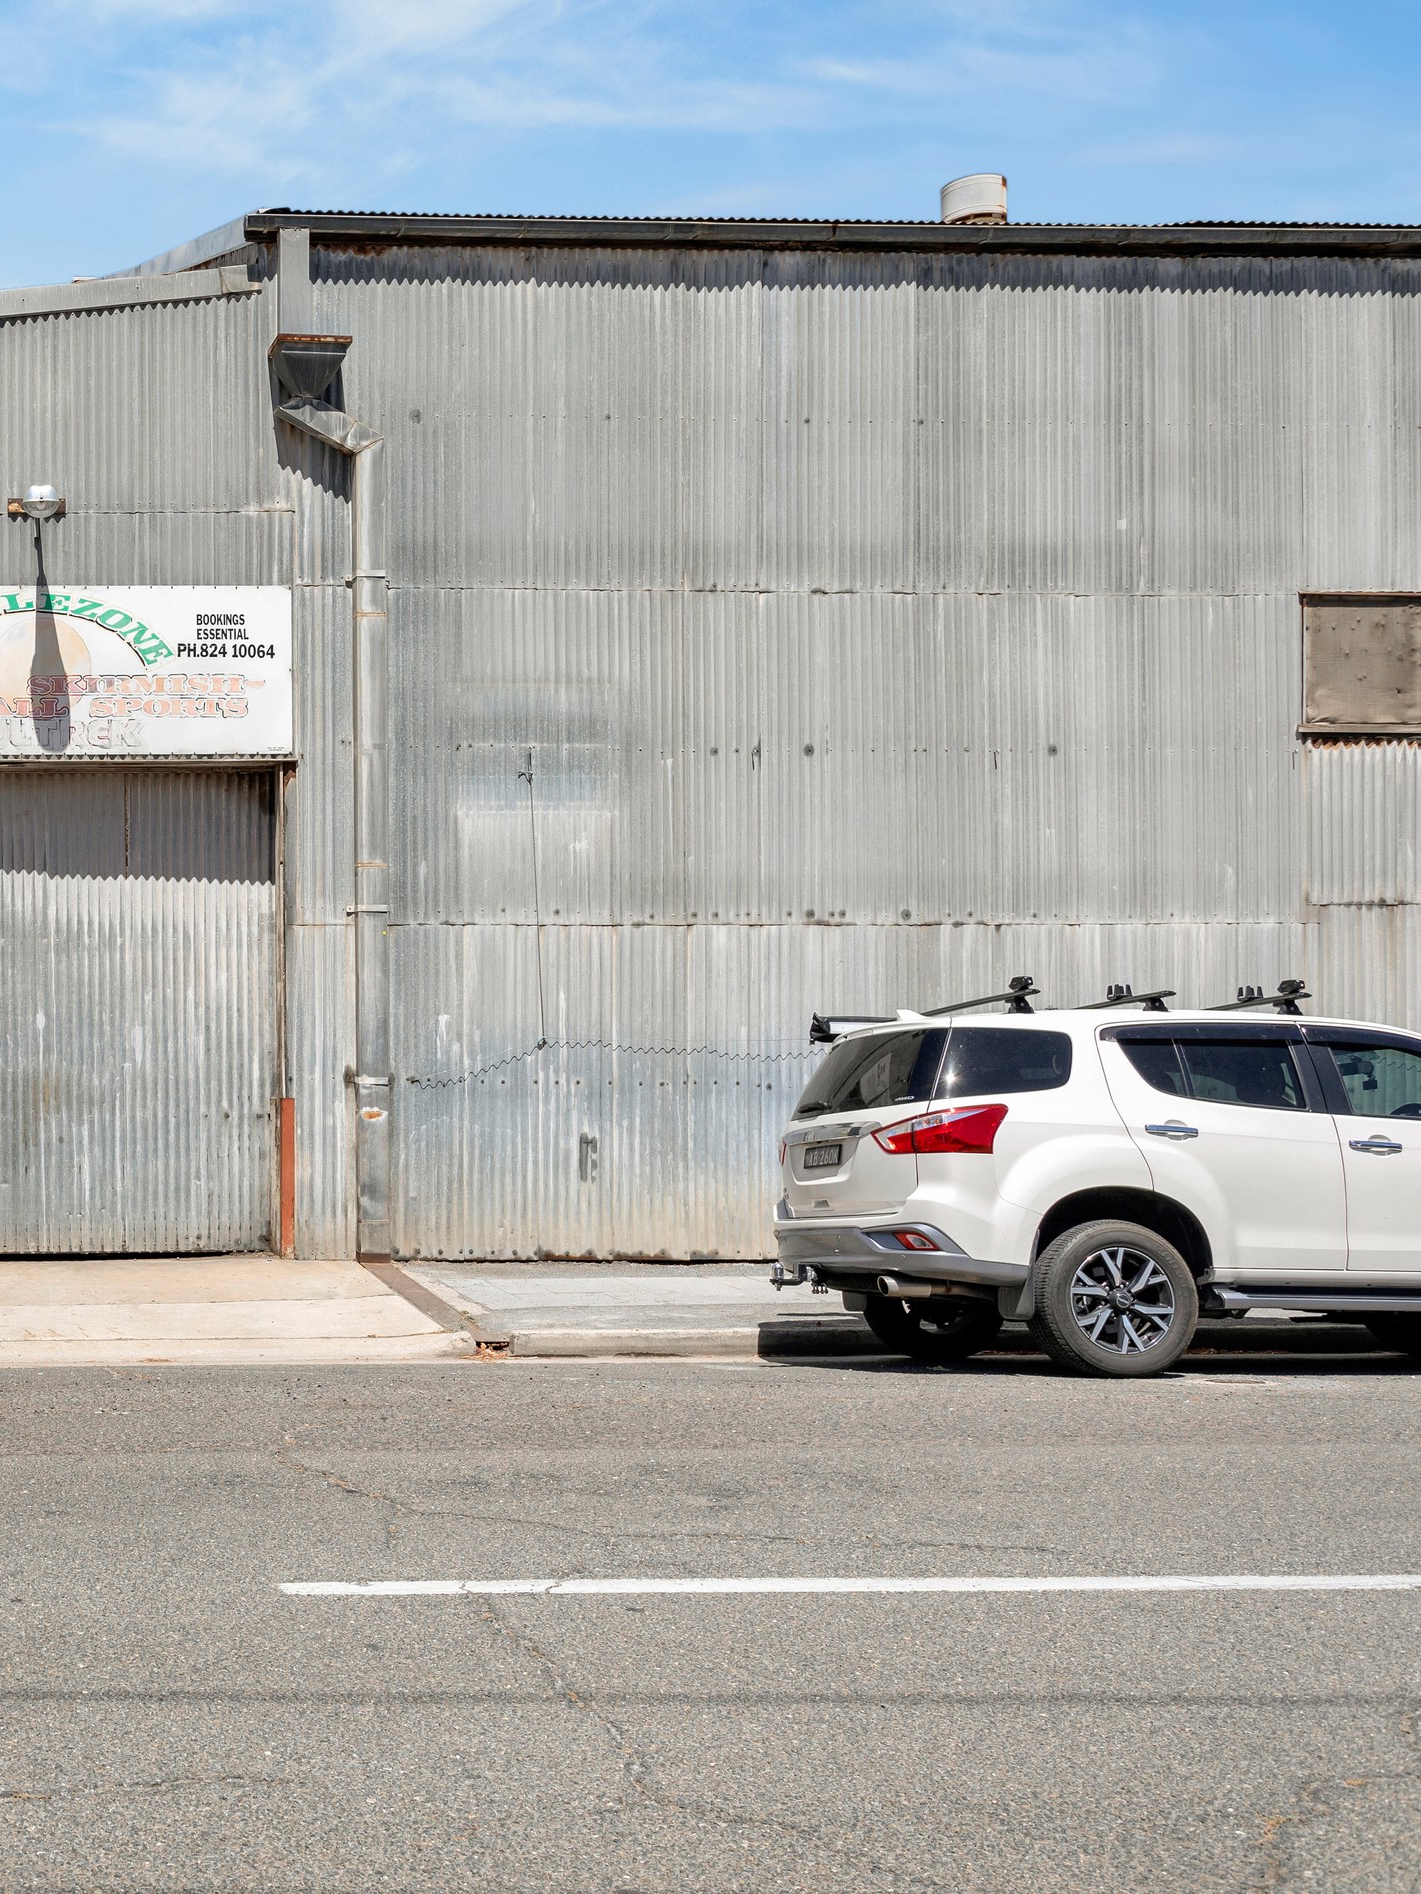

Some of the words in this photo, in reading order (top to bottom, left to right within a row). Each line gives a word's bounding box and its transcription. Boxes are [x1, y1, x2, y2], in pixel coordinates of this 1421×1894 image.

[196, 614, 245, 625] BOOKINGS
[196, 628, 249, 640] ESSENTIAL
[177, 643, 227, 658] PH.824
[231, 643, 276, 659] 10064
[88, 697, 249, 718] SPORTS
